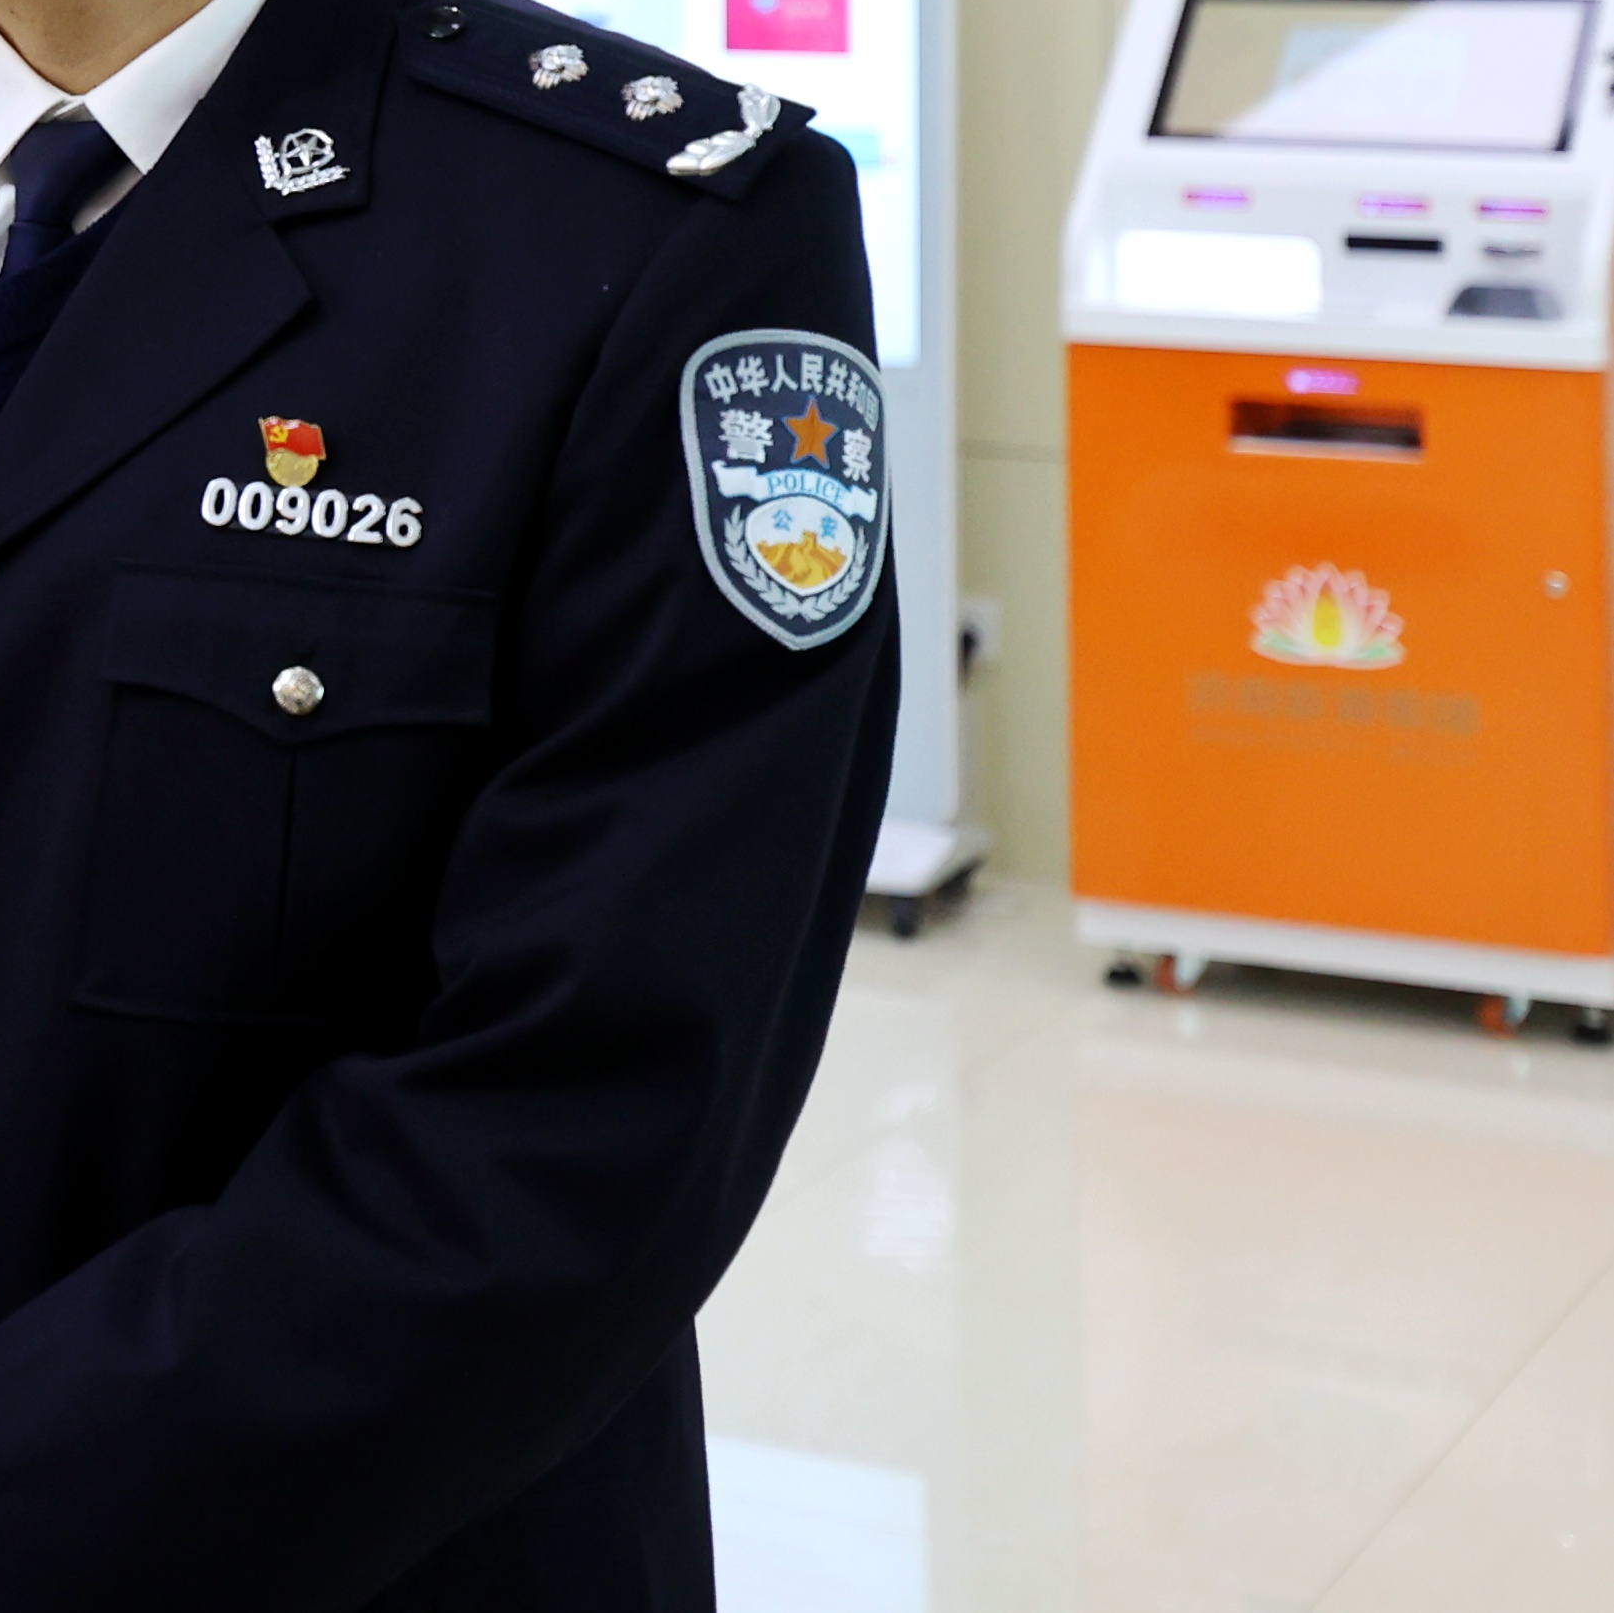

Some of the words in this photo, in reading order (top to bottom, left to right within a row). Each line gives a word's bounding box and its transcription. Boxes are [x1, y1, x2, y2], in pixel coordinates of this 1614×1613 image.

[705, 353, 880, 432] 中华人民共和国
[201, 477, 424, 548] 009026
[767, 472, 847, 507] POLICE
